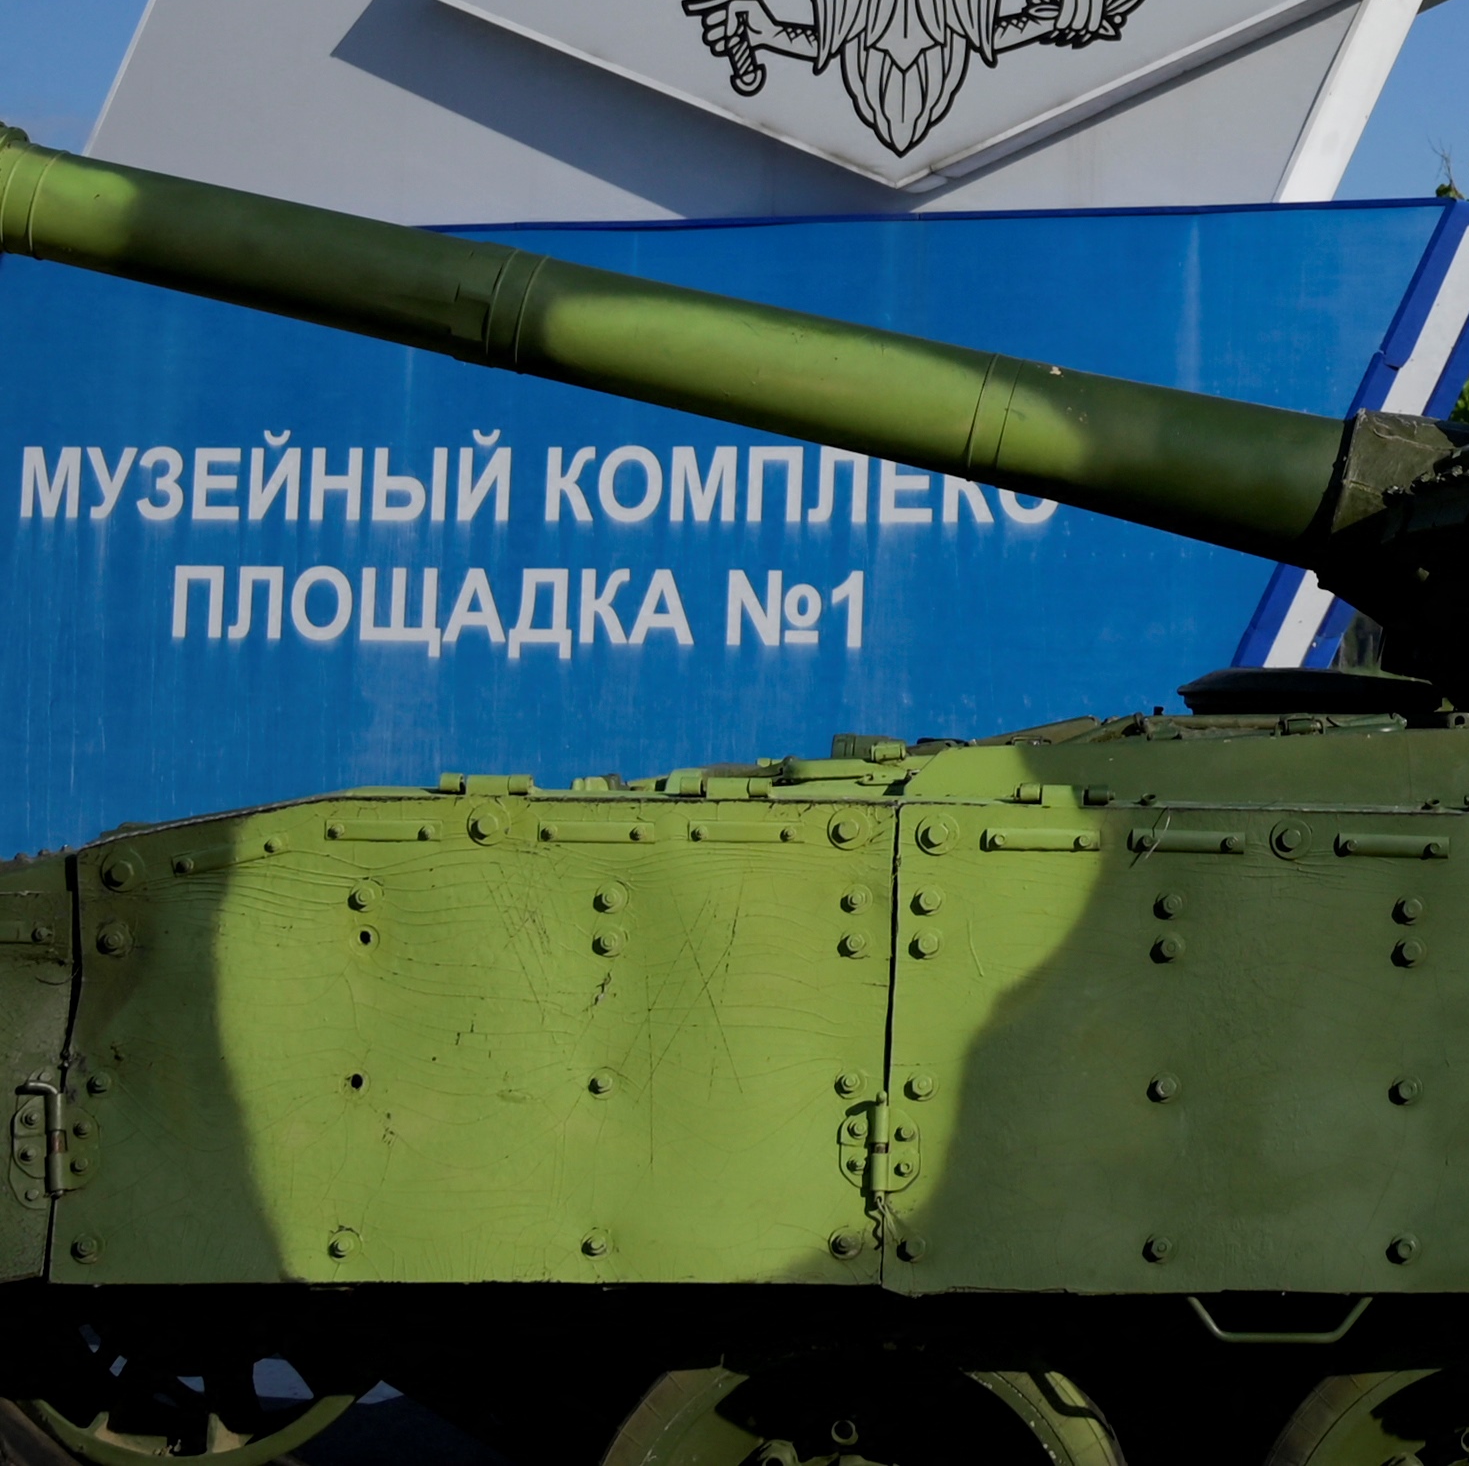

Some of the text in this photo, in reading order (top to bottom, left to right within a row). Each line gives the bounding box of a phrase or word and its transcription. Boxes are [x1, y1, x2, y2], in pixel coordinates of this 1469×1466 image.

[20, 429, 512, 523] МУЗЕЙНЫЙ
[172, 565, 865, 660] ПЛОЩАДКА №1
